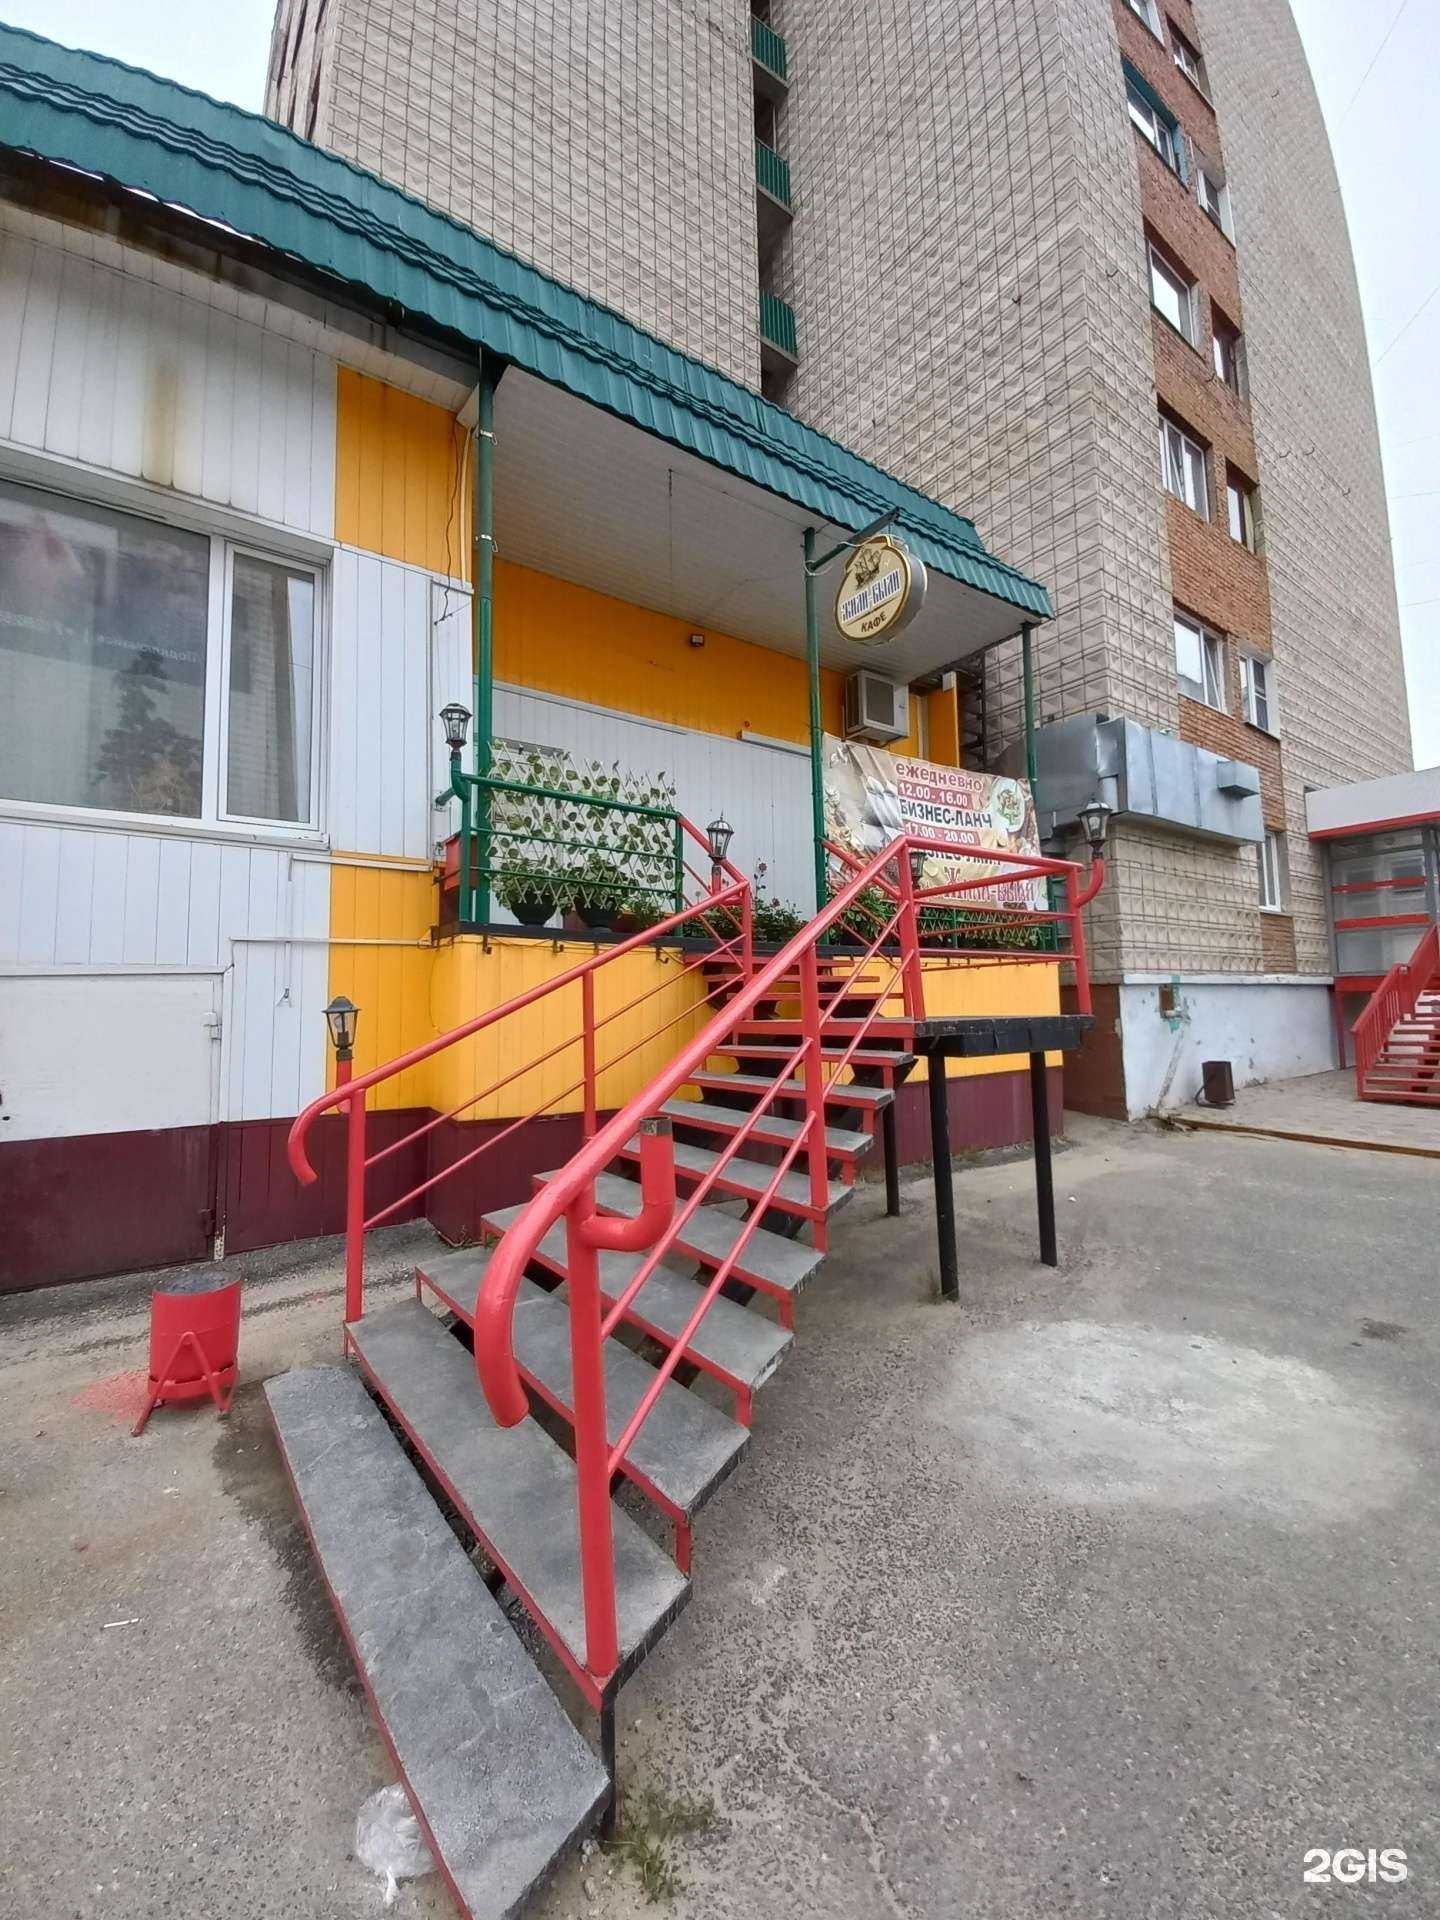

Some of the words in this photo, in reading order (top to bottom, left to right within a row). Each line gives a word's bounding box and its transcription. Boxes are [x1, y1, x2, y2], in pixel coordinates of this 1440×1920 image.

[861, 612, 887, 633] КАФЕ
[895, 763, 983, 792] ежедневно
[939, 790, 968, 806] 16.00
[899, 799, 992, 828] БИЗНЕС-ЛАНЧ
[905, 822, 936, 838] 17.00
[944, 830, 974, 843] 20.00
